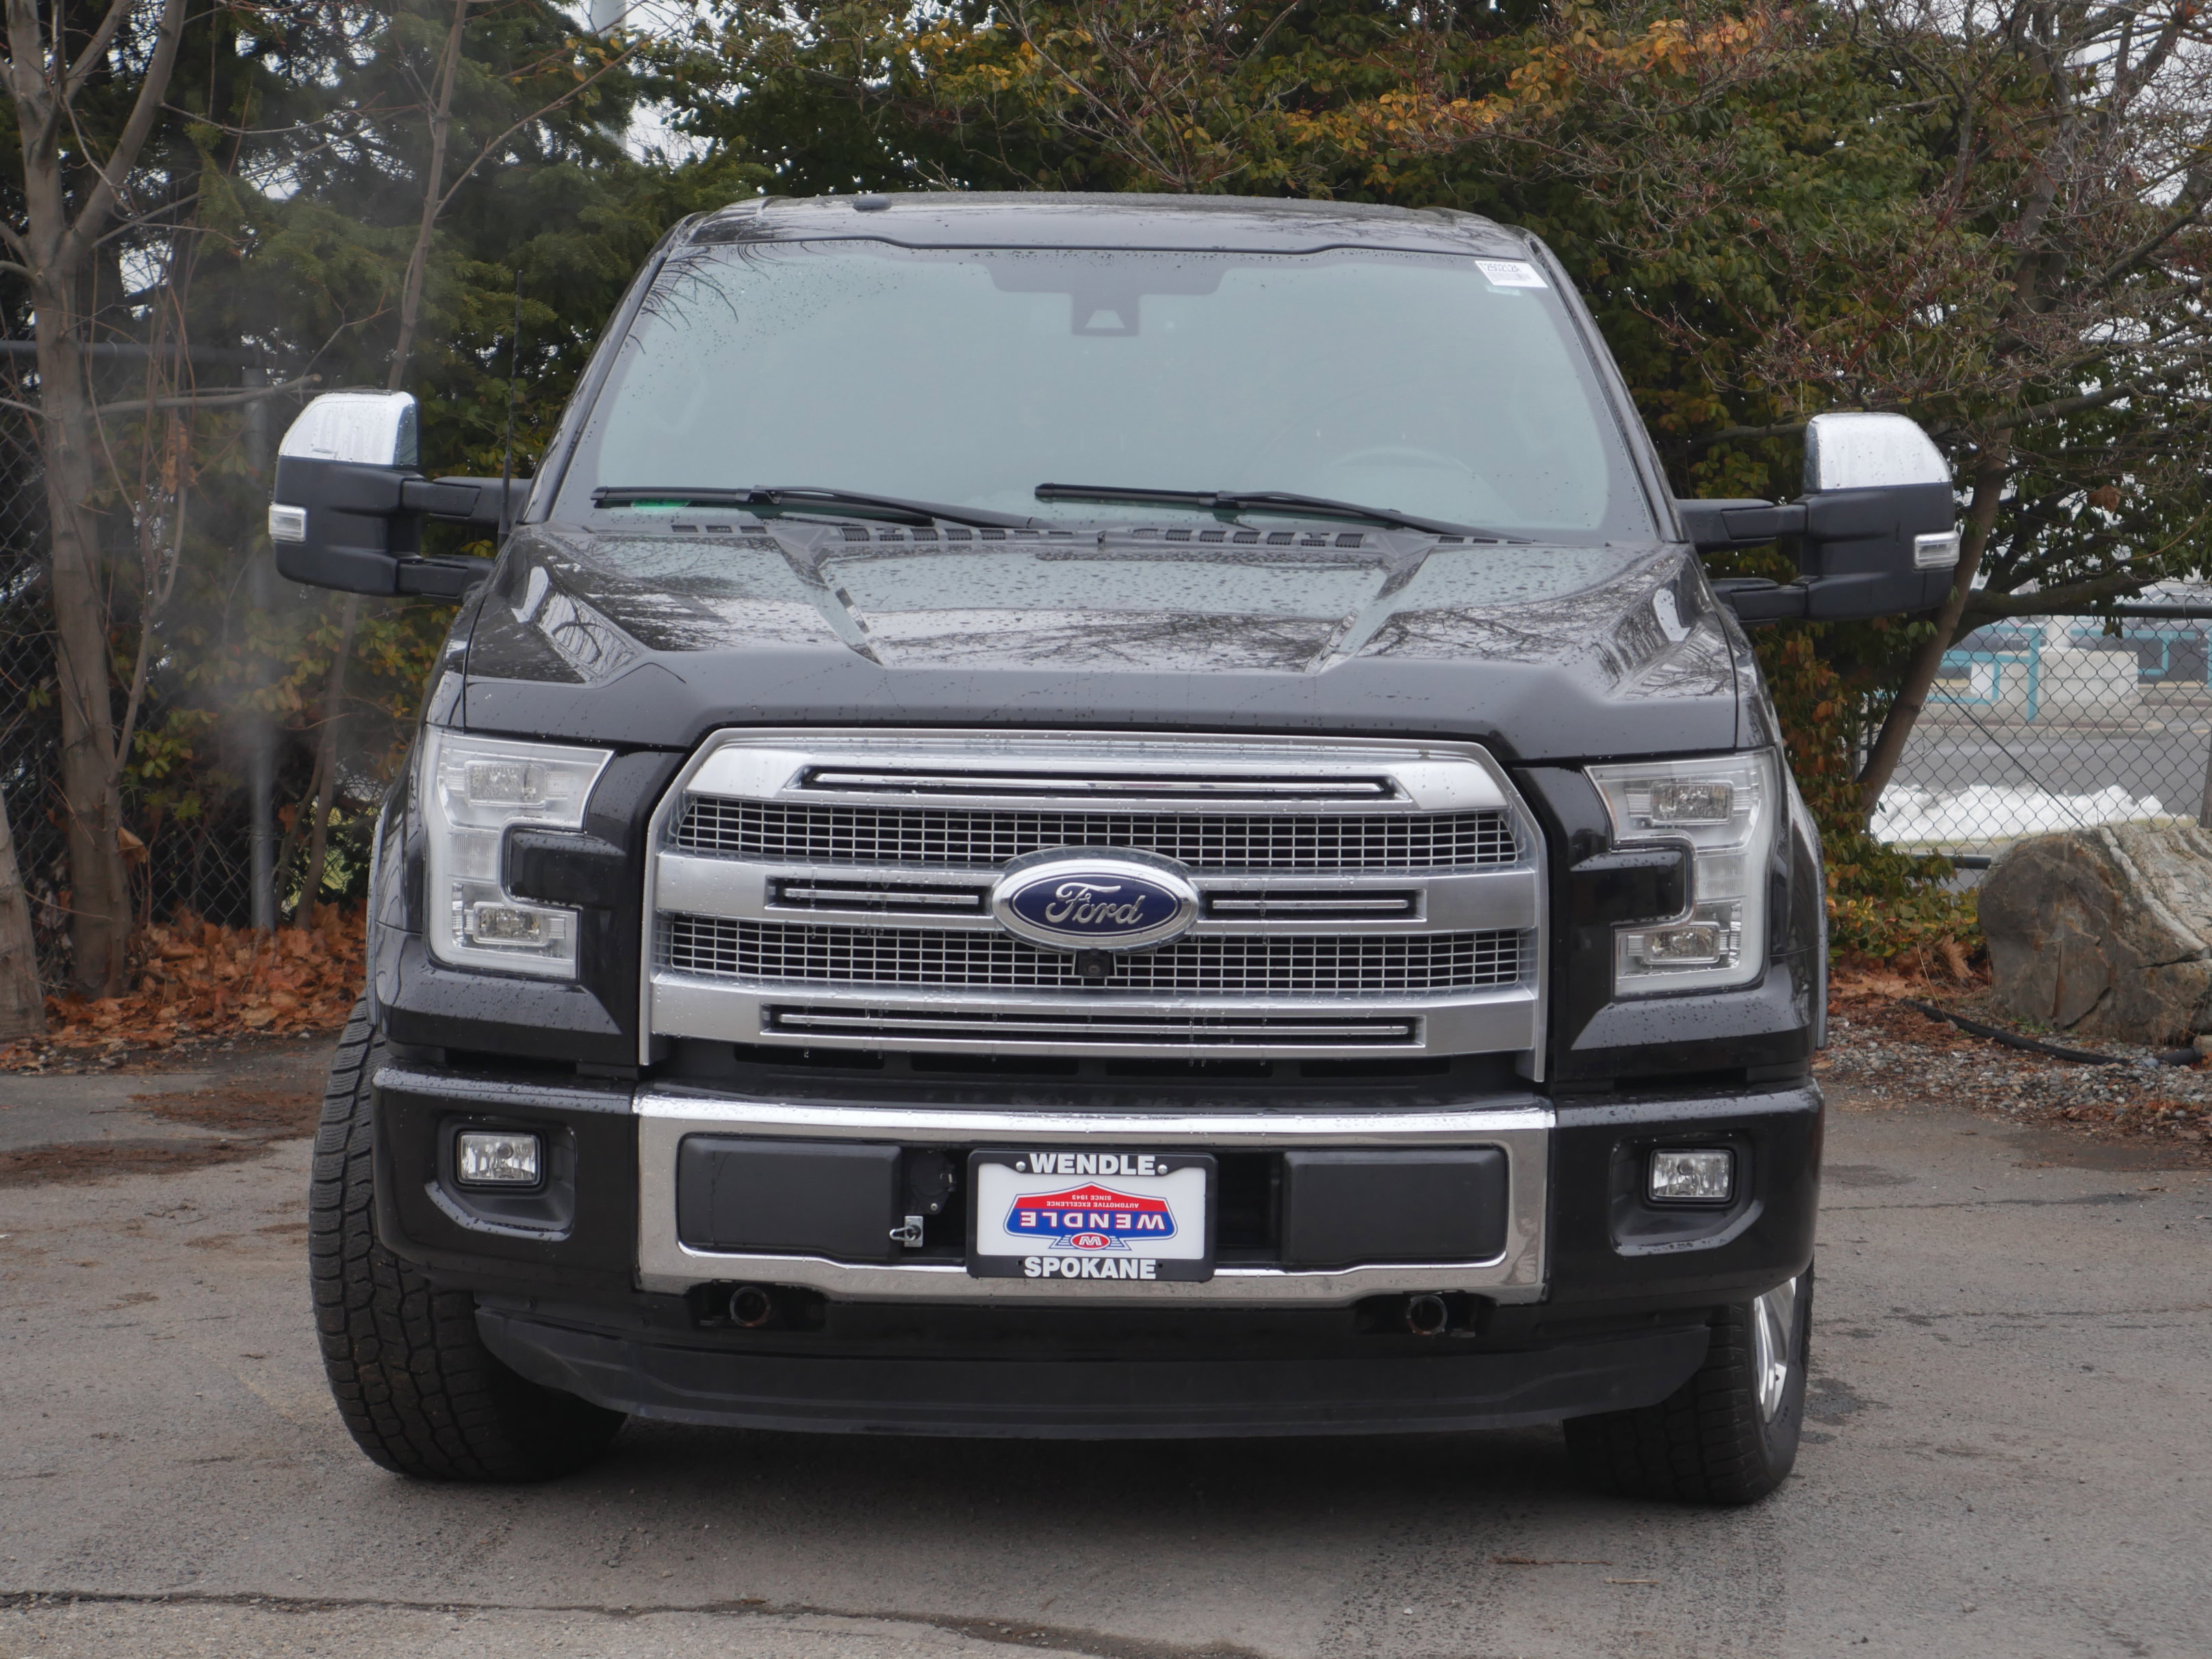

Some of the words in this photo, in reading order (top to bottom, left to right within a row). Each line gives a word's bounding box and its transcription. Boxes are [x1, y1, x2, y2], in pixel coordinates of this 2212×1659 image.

[1046, 882, 1146, 924] Ford
[1030, 1153, 1155, 1176] WENDLE
[1020, 1211, 1166, 1230] WENDLE
[1025, 1257, 1156, 1279] SPOKANE
